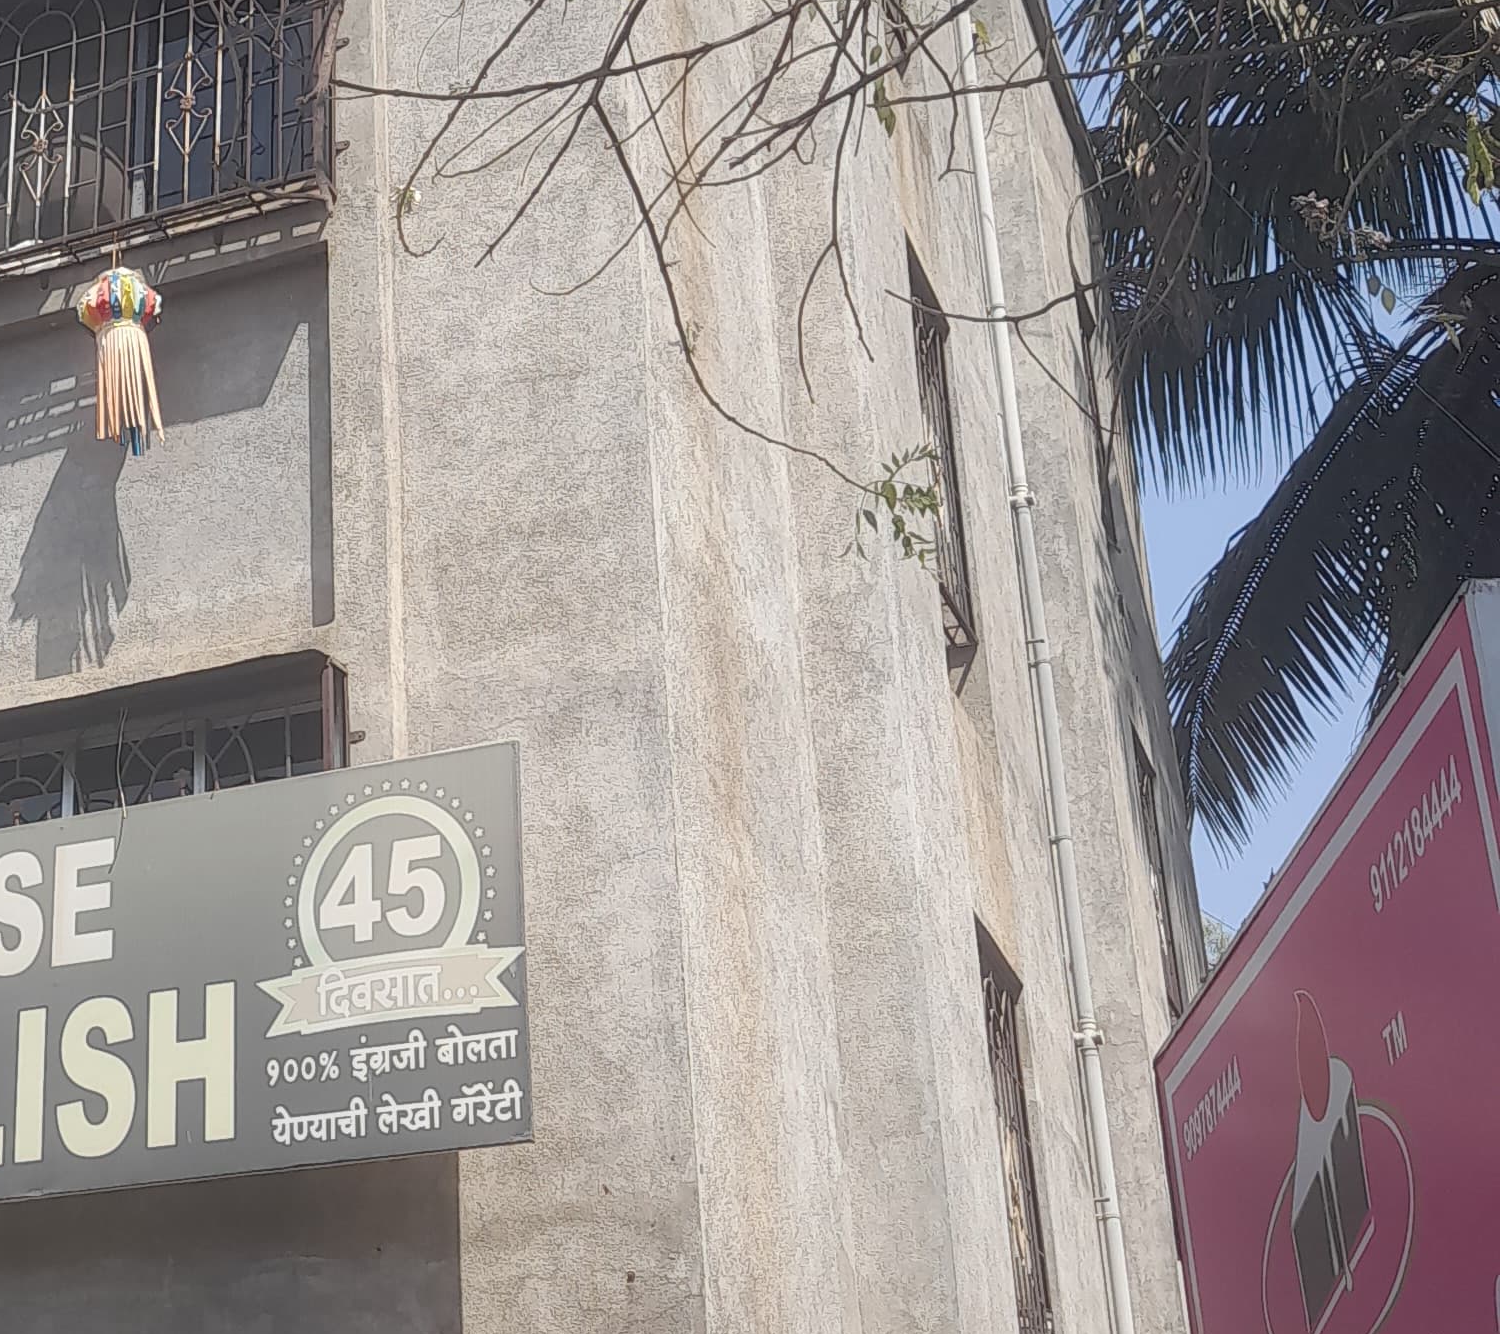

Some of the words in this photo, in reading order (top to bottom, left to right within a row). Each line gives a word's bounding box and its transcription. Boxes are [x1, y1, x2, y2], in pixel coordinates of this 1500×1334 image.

[1370, 754, 1462, 913] 9112184444
[318, 834, 446, 943] 45
[349, 1029, 428, 1082] इंग्रजी
[435, 1024, 519, 1066] बोलता
[1382, 1010, 1408, 1066] TM
[271, 1096, 369, 1147] येण्याची
[375, 1087, 442, 1135] लेखी
